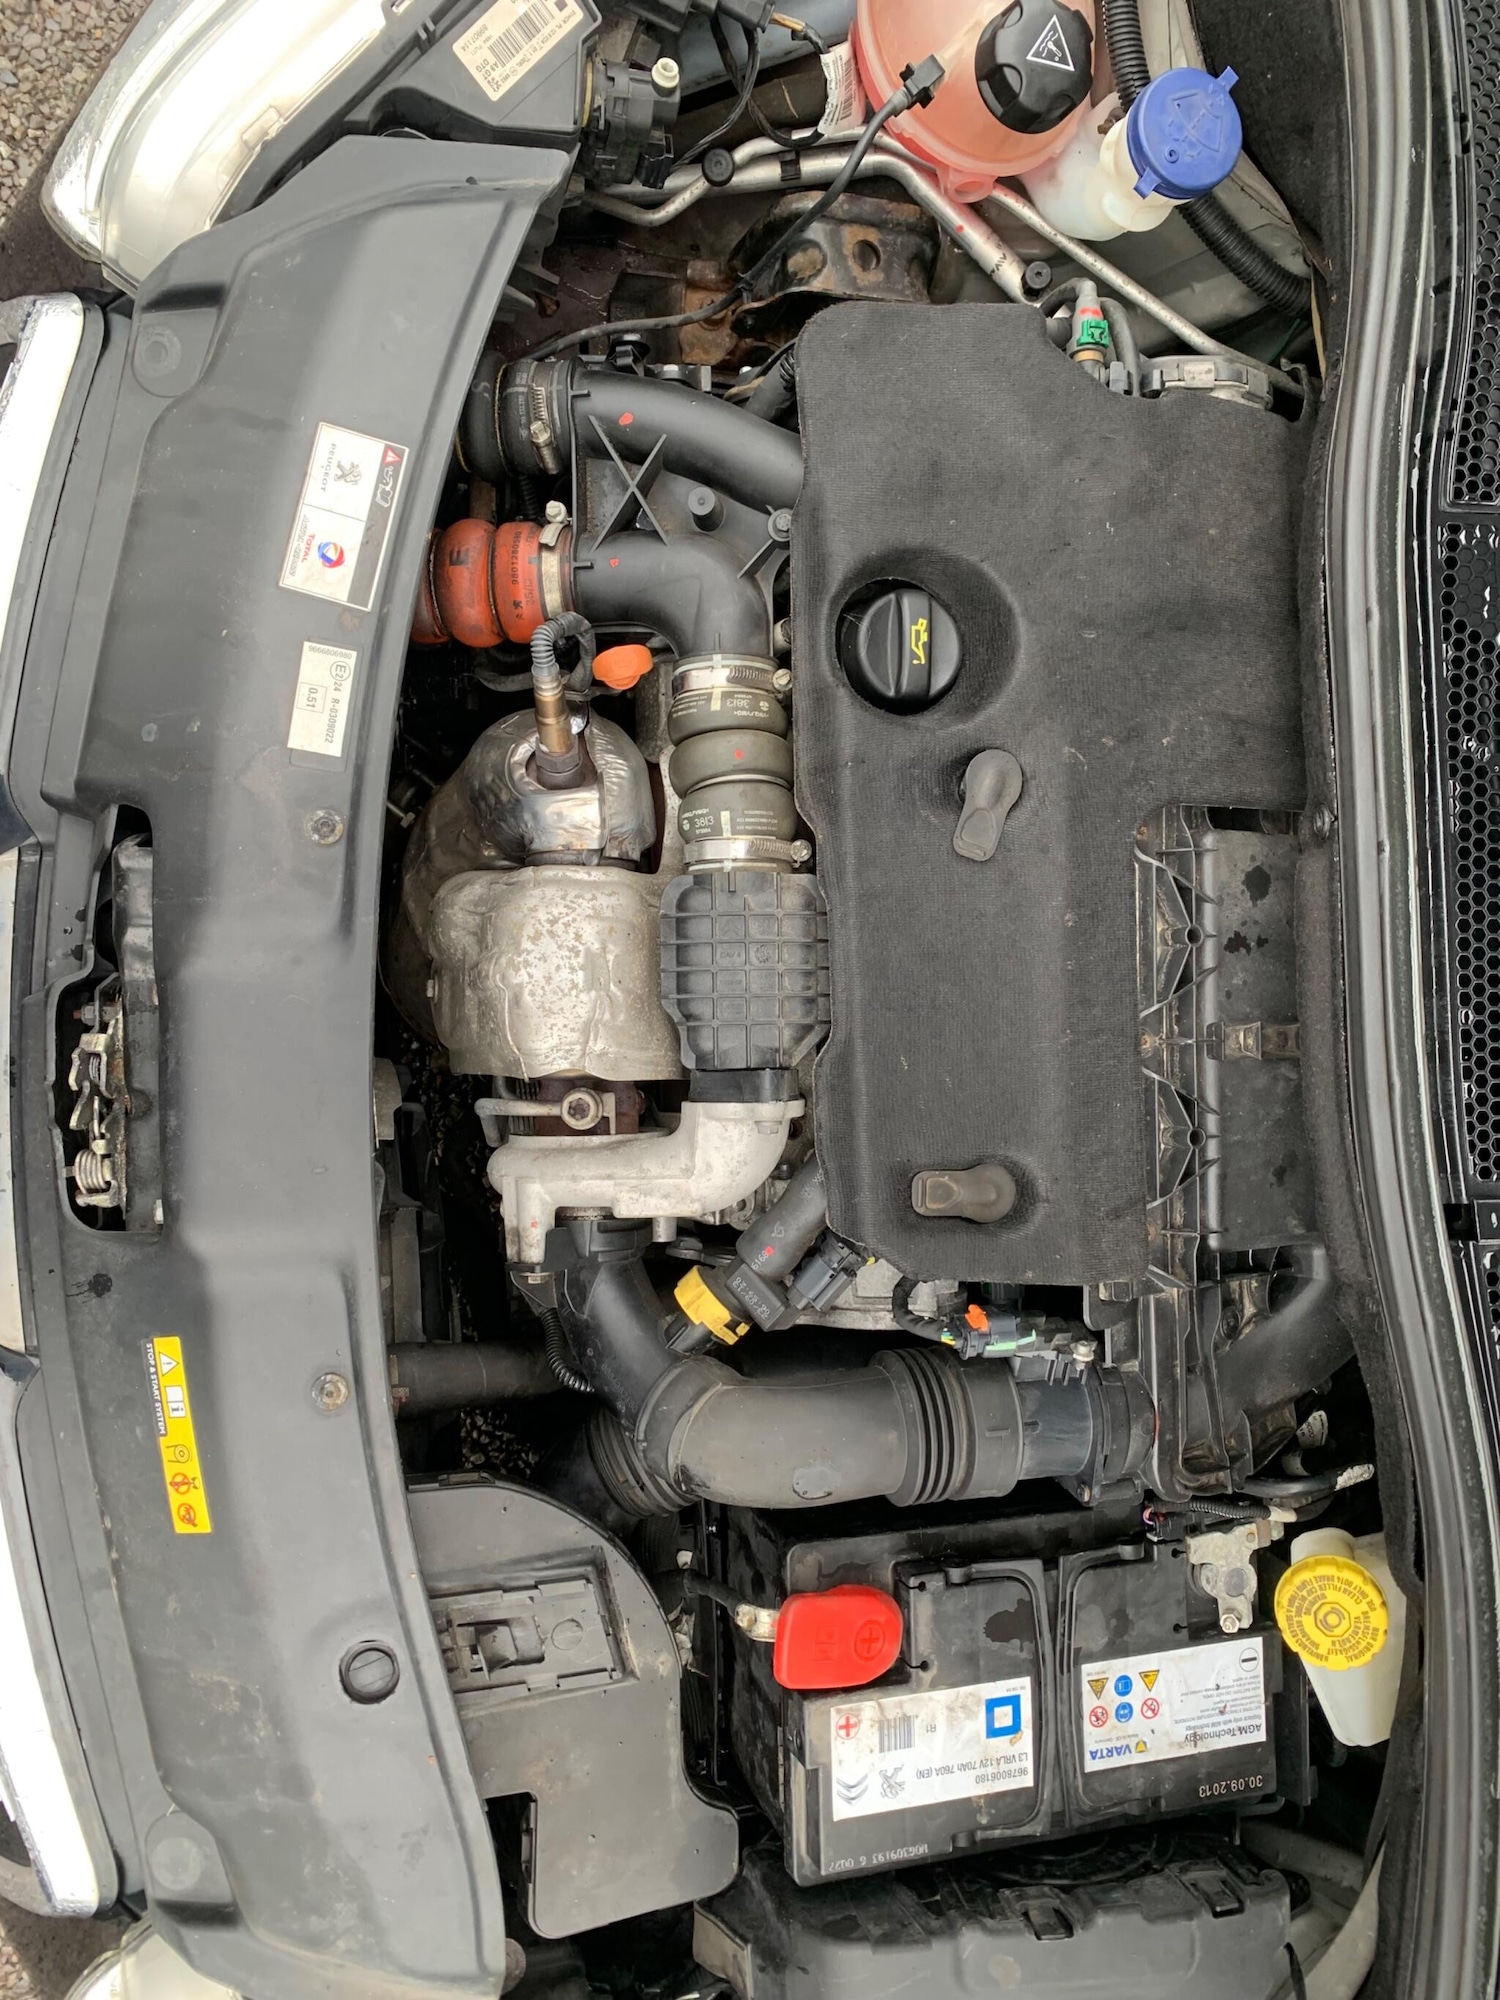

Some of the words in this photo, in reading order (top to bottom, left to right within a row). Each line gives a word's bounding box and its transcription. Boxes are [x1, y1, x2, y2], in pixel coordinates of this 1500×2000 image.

[461, 24, 489, 52] 89907114
[476, 58, 490, 72] DTG
[482, 70, 492, 80] GT
[320, 443, 336, 492] PEUGEOT
[302, 533, 316, 563] TOTAL
[308, 645, 352, 660] 9666806980
[334, 681, 342, 692] 24
[306, 687, 318, 708] 0.51
[325, 697, 340, 744] R-0309022
[146, 1342, 155, 1364] STOP
[151, 1375, 160, 1400] START
[154, 1402, 166, 1434] SYSTEM
[1318, 1584, 1341, 1592] FILLER
[1342, 1587, 1362, 1605] CLEAN
[1352, 1585, 1369, 1601] ONLY
[1366, 1600, 1377, 1612] USE
[1286, 1614, 1298, 1638] SEALED
[1296, 1637, 1329, 1662] CONTAINER
[1345, 1642, 1374, 1663] ORIGINAL
[926, 1724, 936, 1733] R1
[1184, 1727, 1235, 1744] Technology
[1239, 1723, 1262, 1735] AGM
[996, 1754, 1018, 1766] VRLA
[1018, 1752, 1028, 1762] L3
[1089, 1744, 1132, 1762] VARTA
[934, 1765, 955, 1776] 760A
[958, 1761, 978, 1772] 70Ah
[979, 1758, 995, 1768] 12V
[916, 1768, 932, 1780] (EN)
[975, 1767, 1028, 1785] 9678006180
[1199, 1775, 1263, 1798] 30.09.2013
